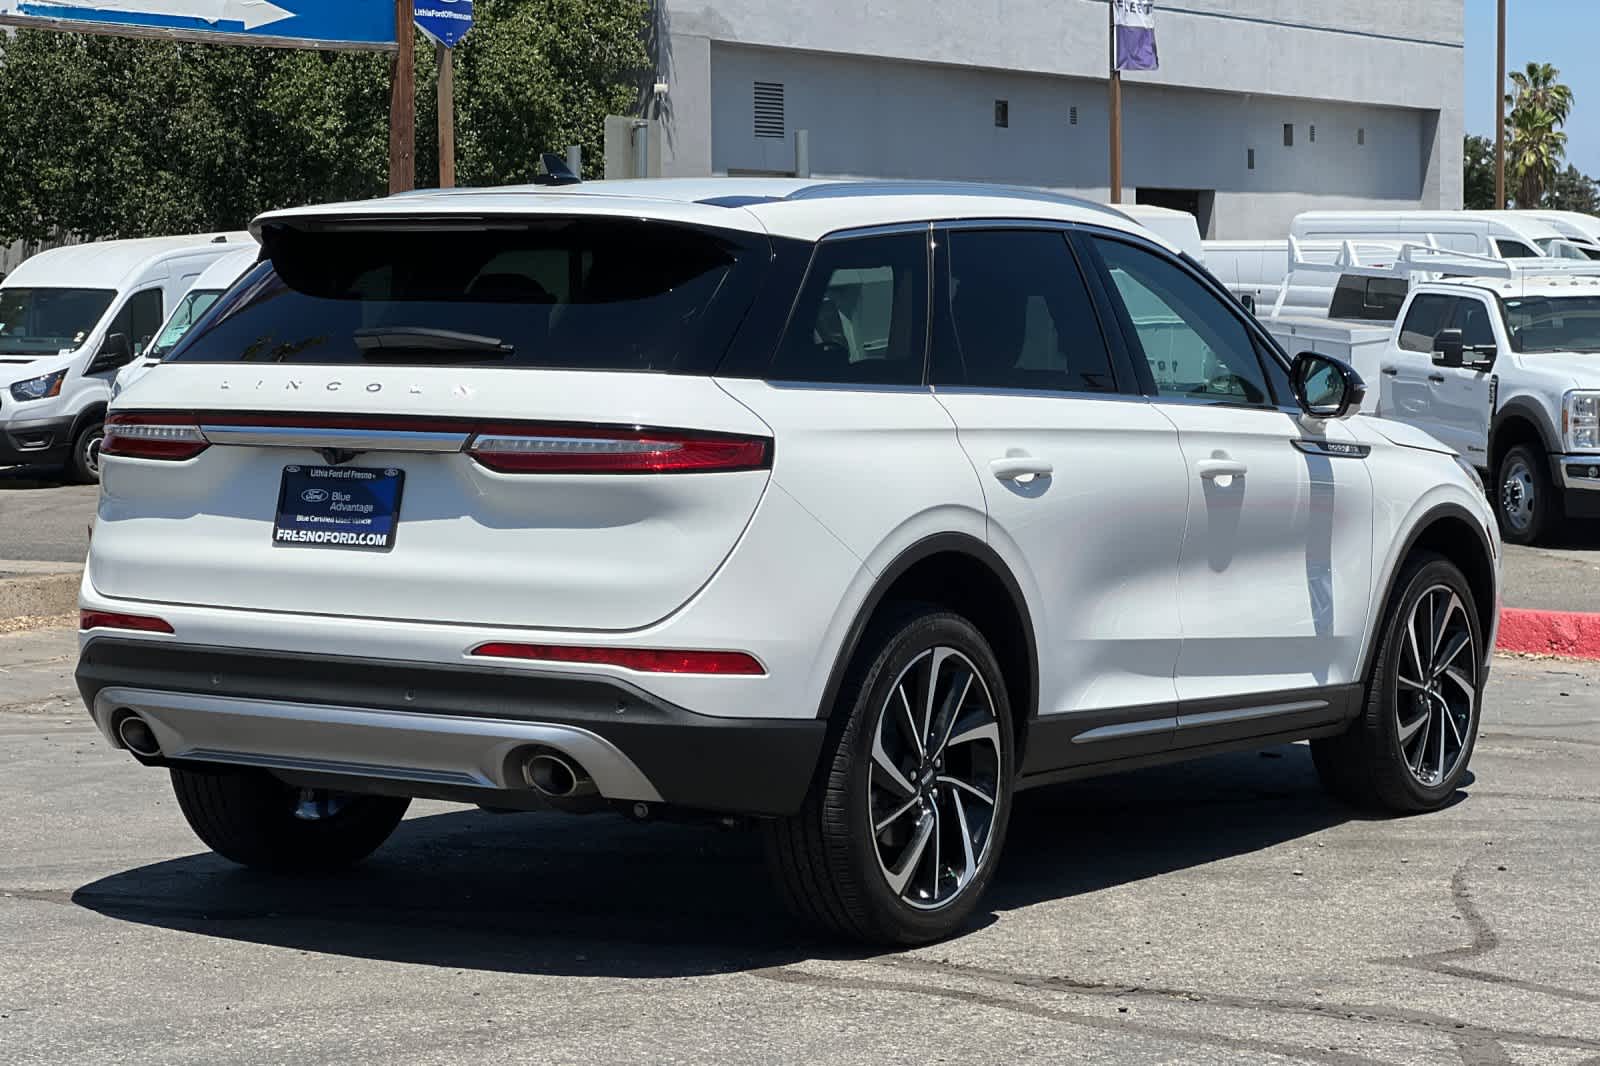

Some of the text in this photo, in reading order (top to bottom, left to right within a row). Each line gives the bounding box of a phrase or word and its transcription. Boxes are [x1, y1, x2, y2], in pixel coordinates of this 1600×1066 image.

[220, 380, 474, 396] LINCOLN
[310, 469, 328, 478] Lithia
[328, 470, 343, 478] Ford
[344, 471, 350, 479] of
[351, 471, 372, 480] Fresno
[331, 491, 351, 502] Blue
[329, 502, 374, 514] Advantage
[276, 529, 387, 546] FRESNOFORD.COM
